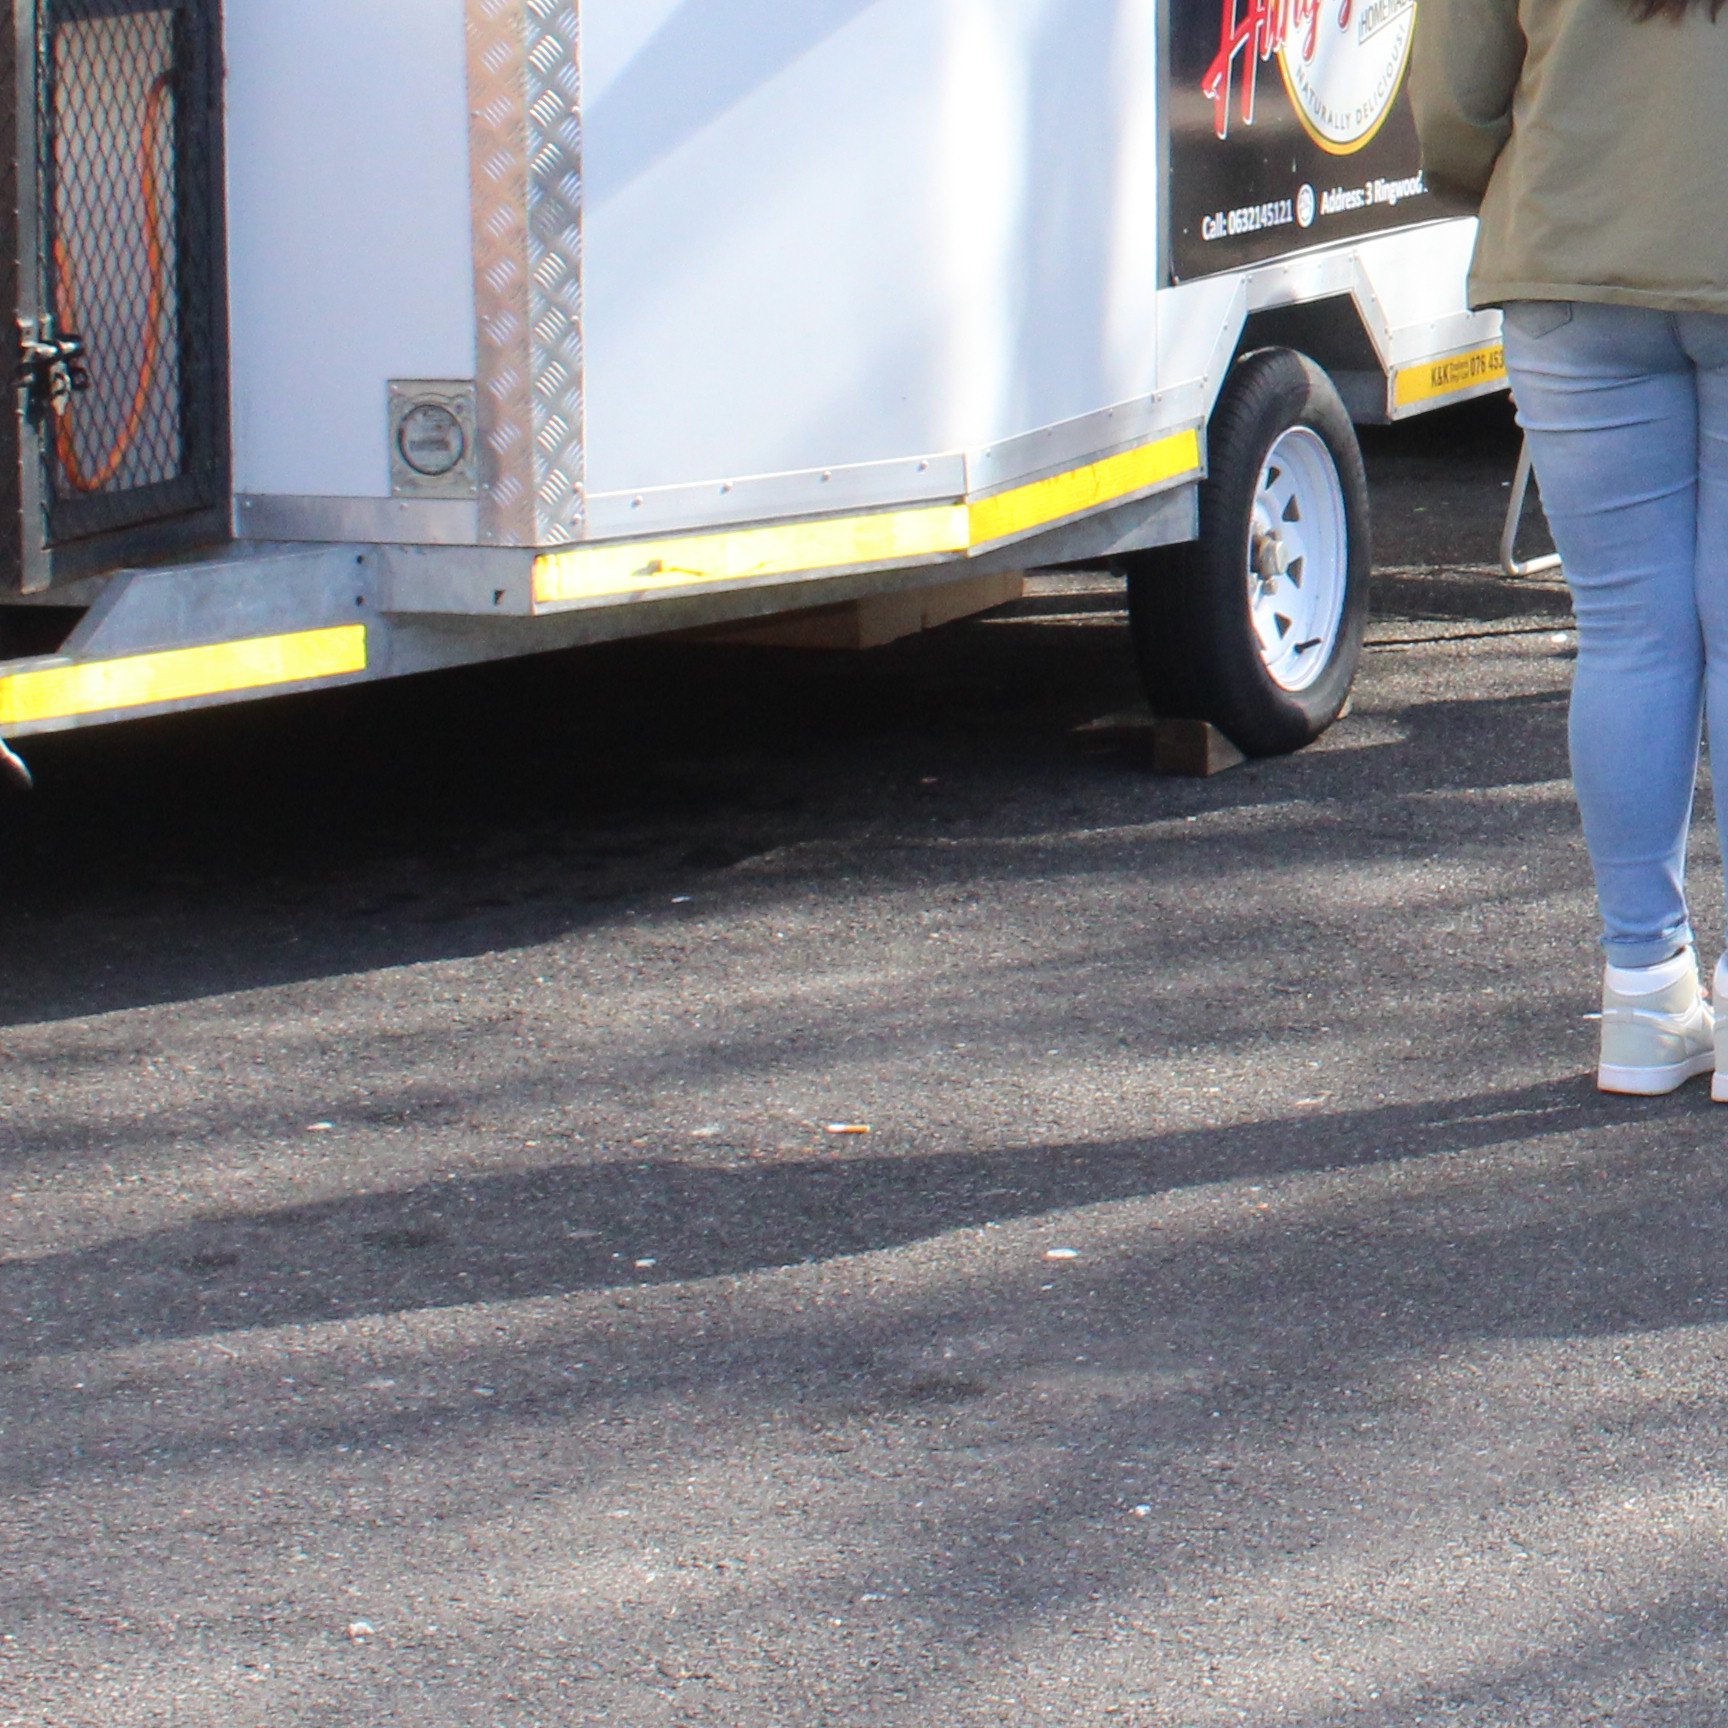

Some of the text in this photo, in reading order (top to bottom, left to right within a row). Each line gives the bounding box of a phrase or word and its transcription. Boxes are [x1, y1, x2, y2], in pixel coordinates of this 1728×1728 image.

[1296, 65, 1353, 131] NATURALLY
[1201, 170, 1424, 241] Call: 0632145121 Address: 3 Ringwood
[1470, 355, 1486, 377] 076
